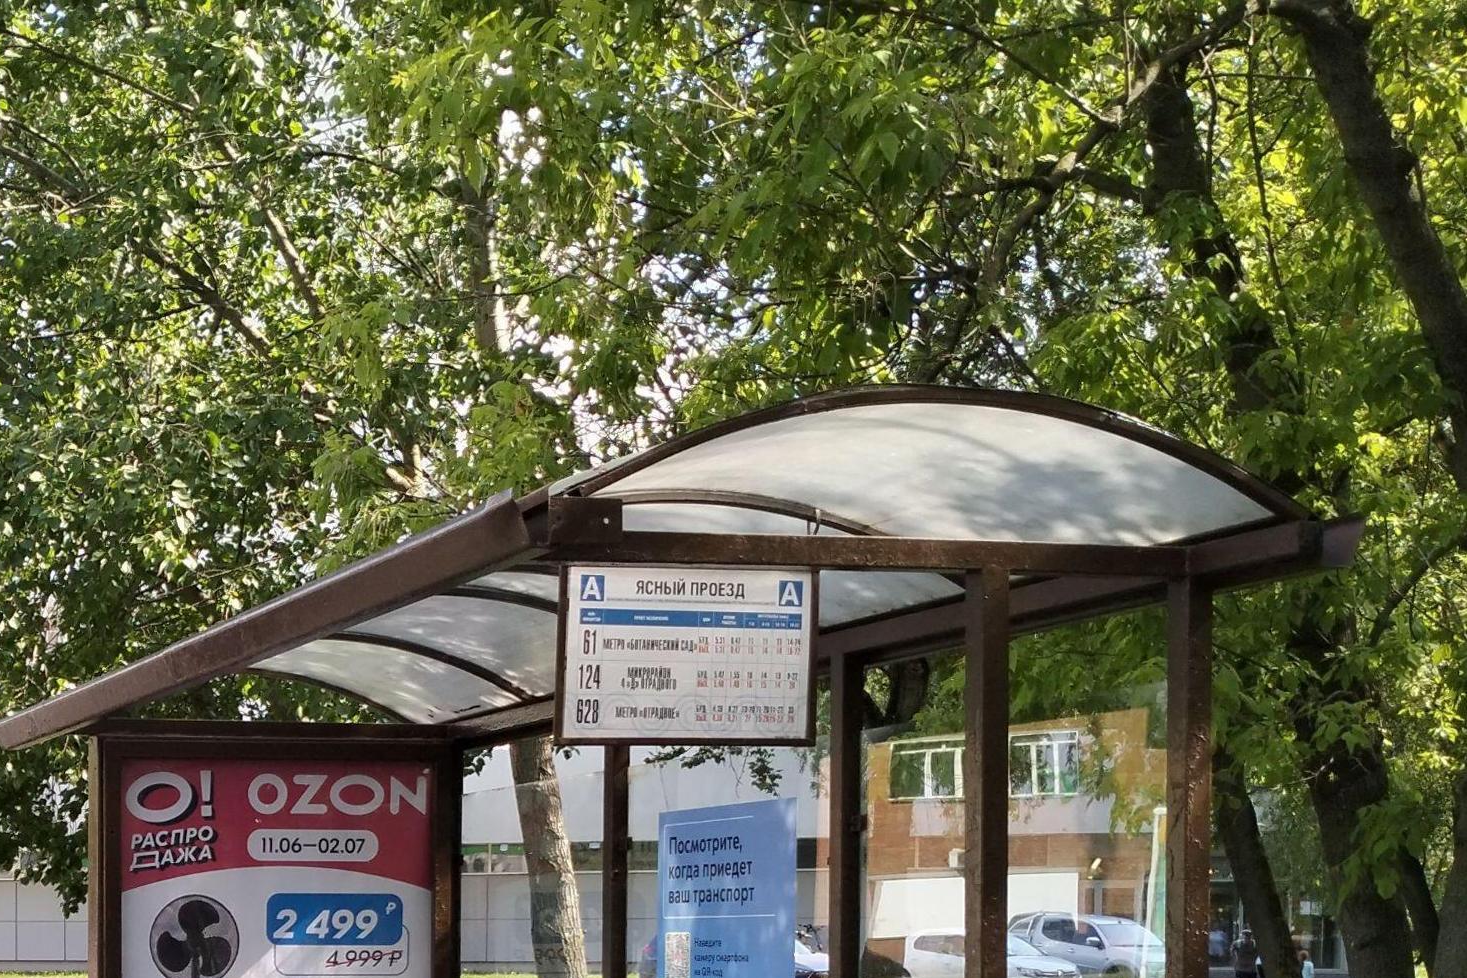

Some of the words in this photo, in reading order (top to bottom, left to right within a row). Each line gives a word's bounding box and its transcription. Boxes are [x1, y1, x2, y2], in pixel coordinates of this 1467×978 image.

[636, 578, 685, 596] ЯСНЫЙ
[690, 581, 745, 599] ПРОЕЗД
[583, 629, 597, 655] 61
[603, 638, 625, 650] МЕТРО
[578, 664, 601, 690] 124
[576, 698, 599, 724] 628
[615, 706, 638, 718] МЕТРО
[247, 773, 427, 816] OZON
[130, 825, 214, 850] РАСПРО
[669, 834, 743, 856] Посмотрите,
[129, 845, 213, 872] ДАЖА
[668, 864, 700, 882] когда
[702, 859, 753, 882] приедет
[668, 890, 690, 904] ваш
[693, 886, 755, 907] транспорт
[694, 938, 722, 948] Наведите
[694, 955, 715, 964] камеру
[716, 954, 749, 964] смартфона
